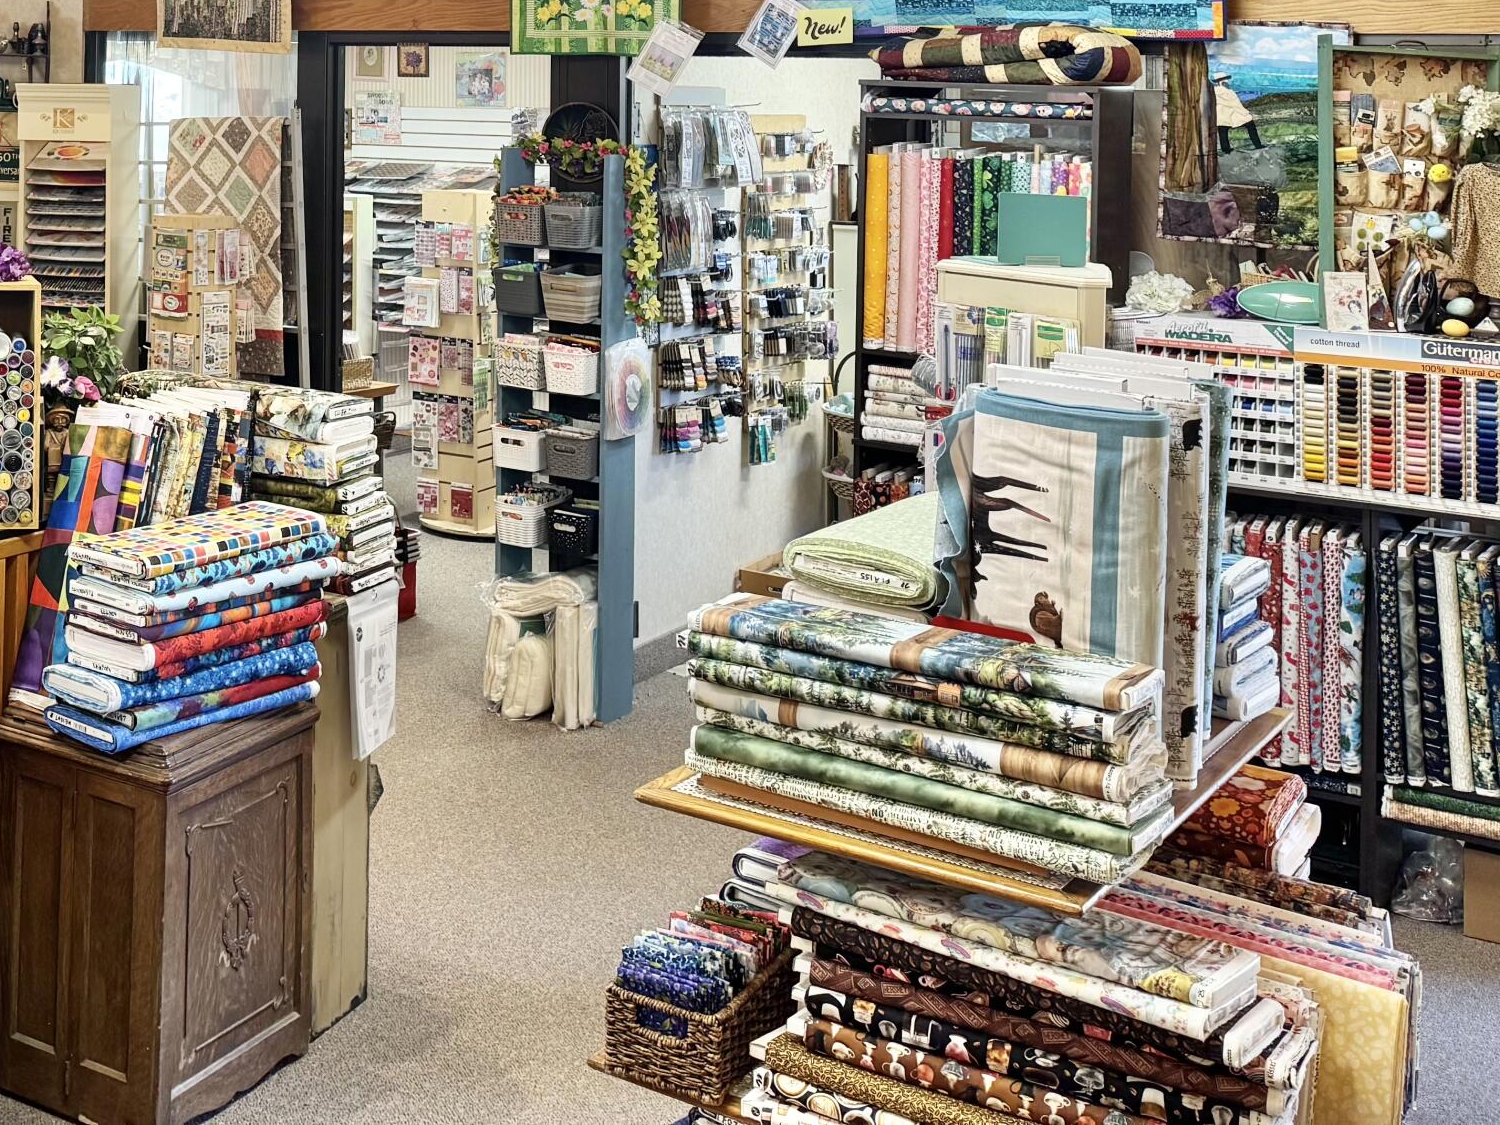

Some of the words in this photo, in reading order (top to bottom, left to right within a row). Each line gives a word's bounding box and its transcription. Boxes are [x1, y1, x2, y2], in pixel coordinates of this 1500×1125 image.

[804, 15, 847, 40] New!
[2, 208, 12, 243] FIRE
[1164, 329, 1233, 344] MADEIRA
[1310, 337, 1334, 347] cotton
[1335, 338, 1360, 349] thread
[1423, 341, 1500, 362] Güterman
[1421, 364, 1446, 374] 100%
[1451, 366, 1485, 377] Natural
